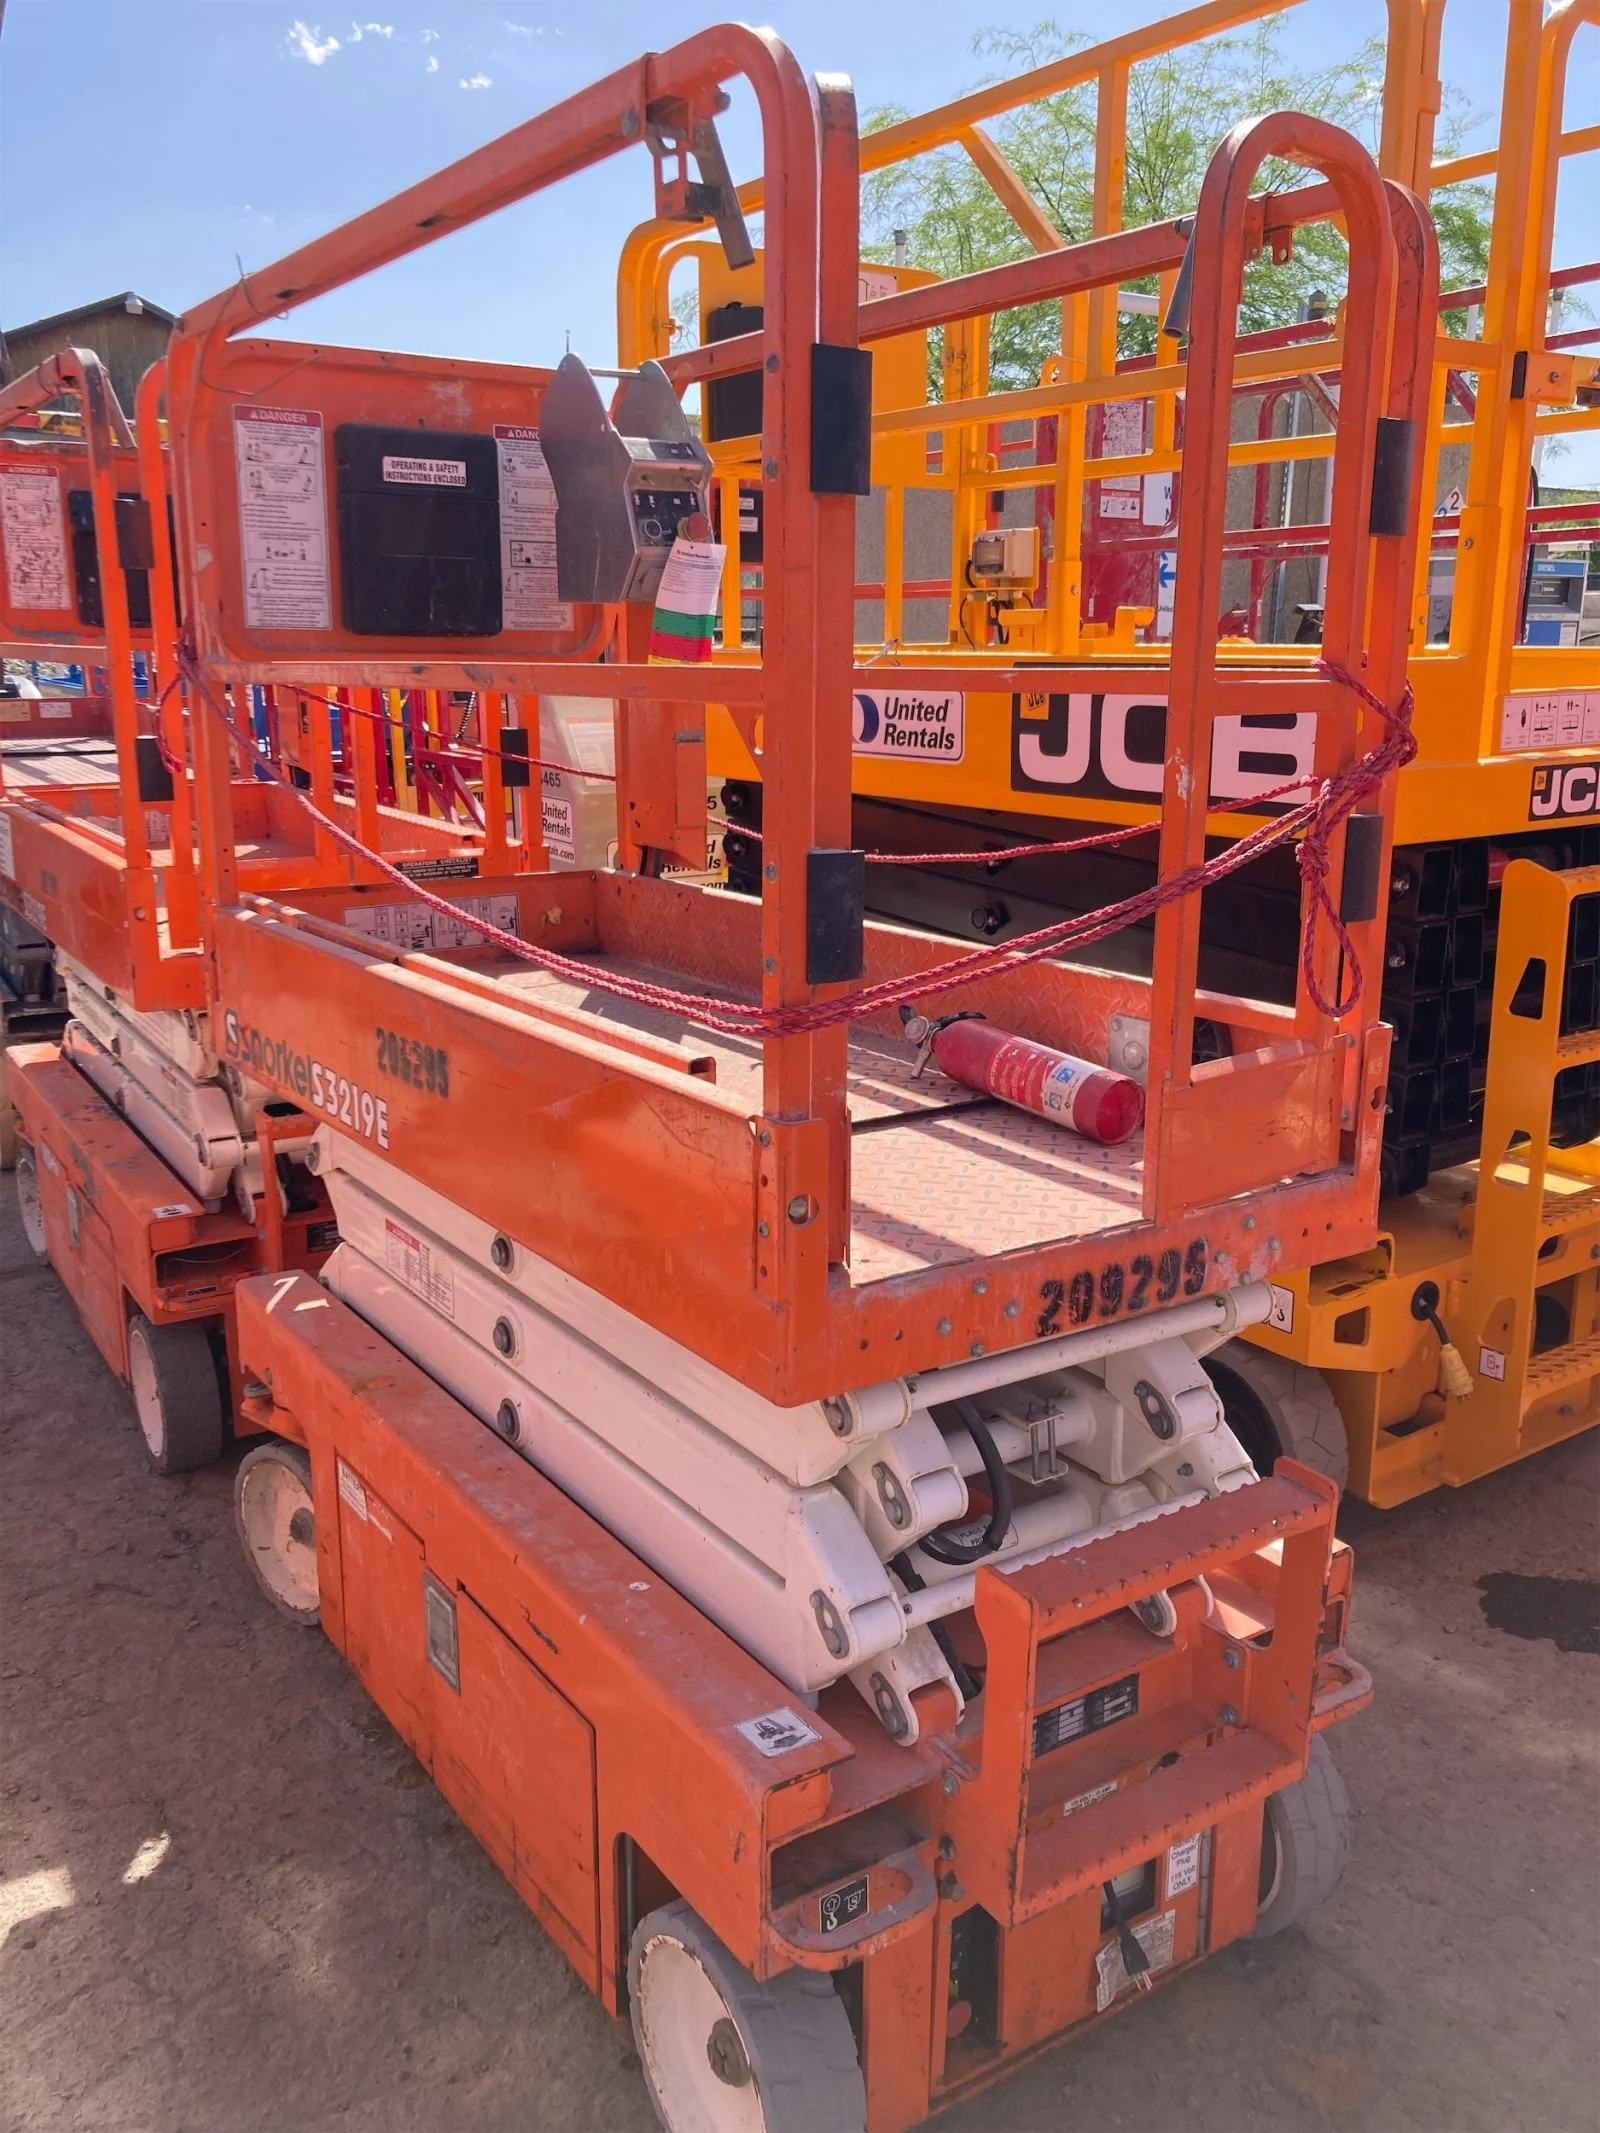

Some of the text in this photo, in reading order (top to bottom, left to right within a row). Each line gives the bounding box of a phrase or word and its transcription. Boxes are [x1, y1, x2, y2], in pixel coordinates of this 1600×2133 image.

[260, 410, 308, 424] DANGER
[12, 466, 48, 475] DANGER
[391, 460, 459, 474] OPERATING & SAFETY
[385, 470, 466, 485] INSTRUCTIONS ENCLOSED
[1450, 491, 1460, 510] 2
[1537, 564, 1556, 572] DIESEL
[884, 696, 950, 723] United
[883, 722, 956, 751] Rentals
[1018, 690, 1318, 803] JCB
[541, 770, 561, 788] 465
[1532, 766, 1600, 817] JC
[312, 1060, 390, 1150] S3219E
